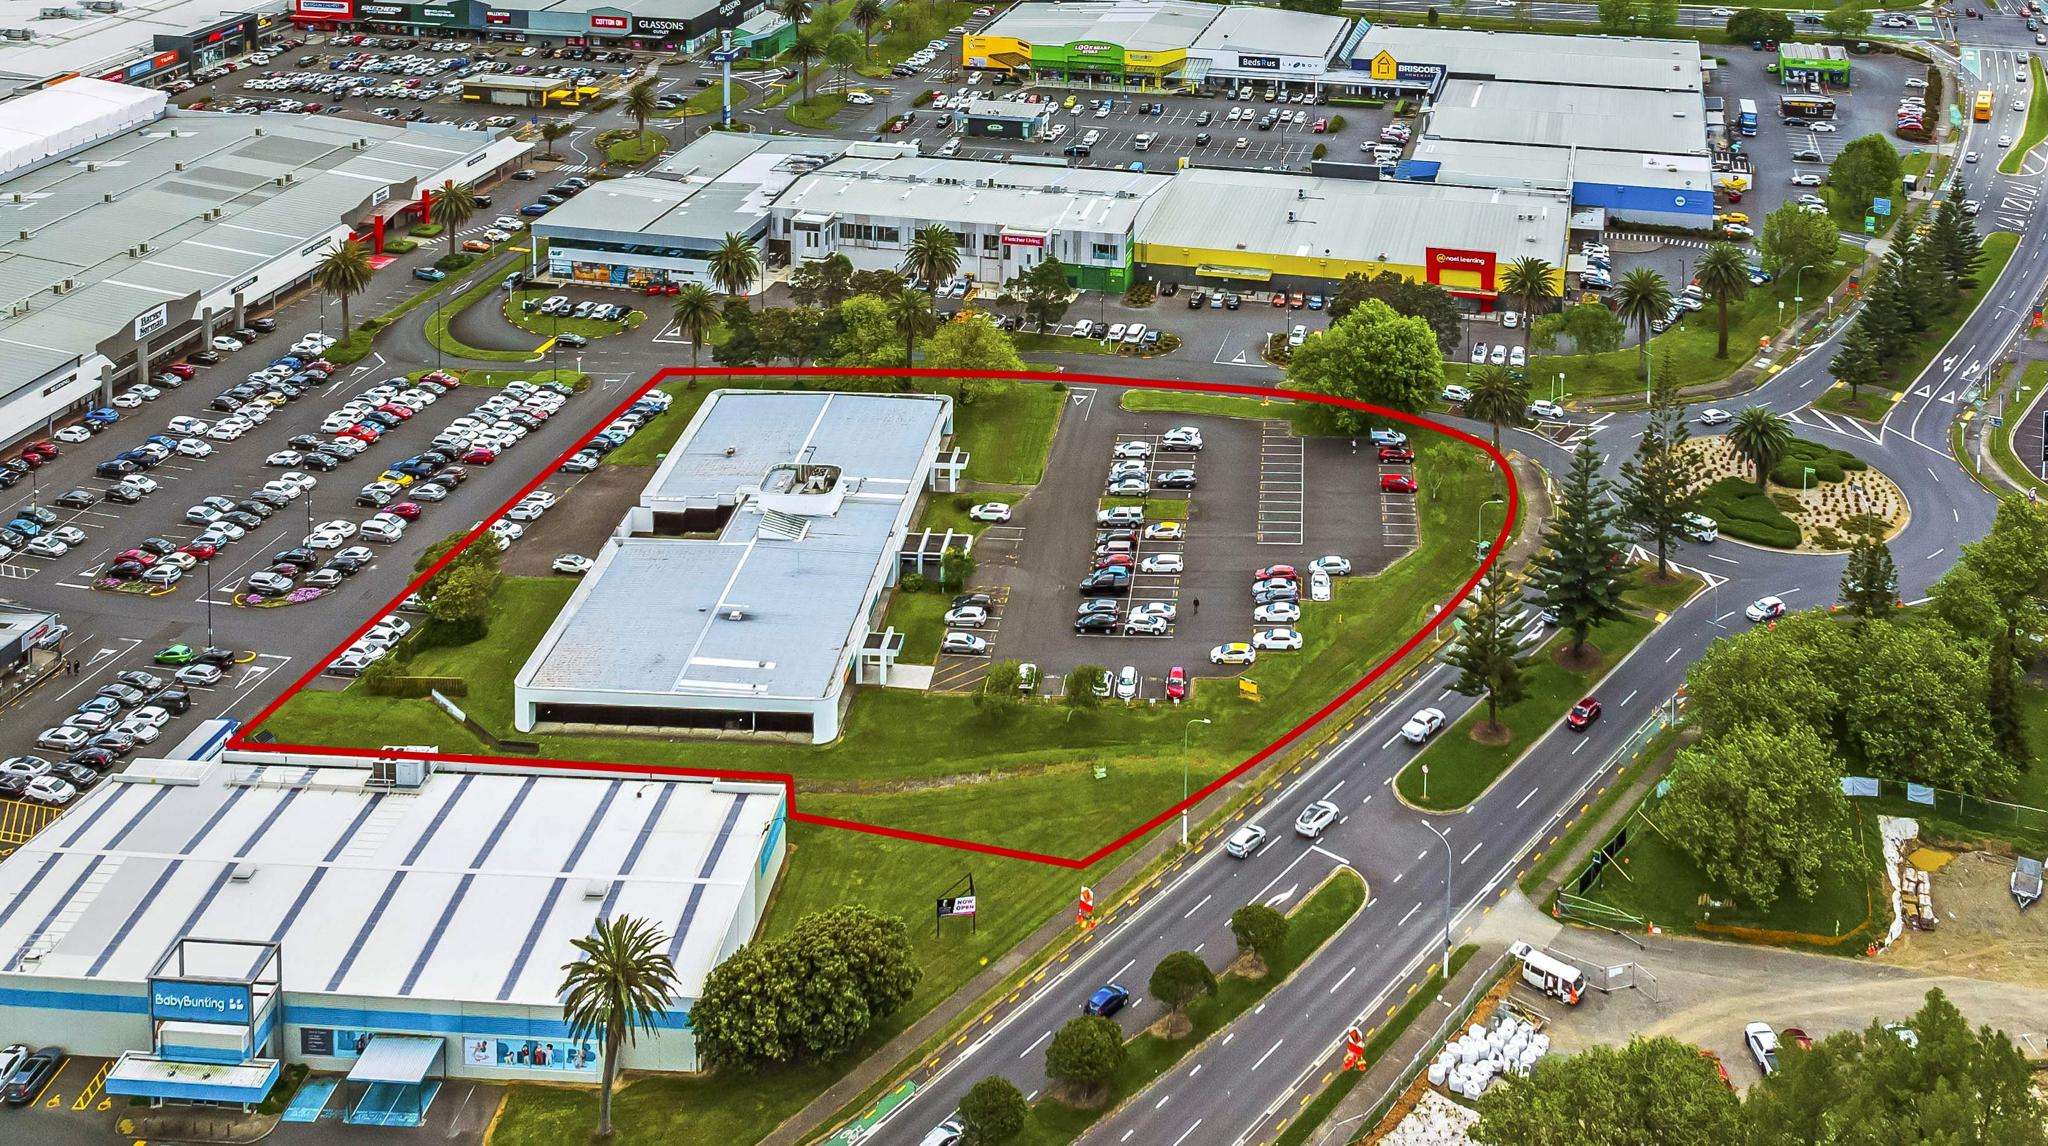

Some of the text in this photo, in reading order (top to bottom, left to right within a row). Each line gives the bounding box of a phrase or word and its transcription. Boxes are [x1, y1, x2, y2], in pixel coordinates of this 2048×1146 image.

[595, 18, 615, 26] COTTON
[638, 20, 684, 30] GLASSONS
[1398, 65, 1442, 74] BRISCOES
[140, 308, 163, 327] Harvey
[139, 318, 164, 337] Norman
[155, 994, 225, 1012] BabyBunting
